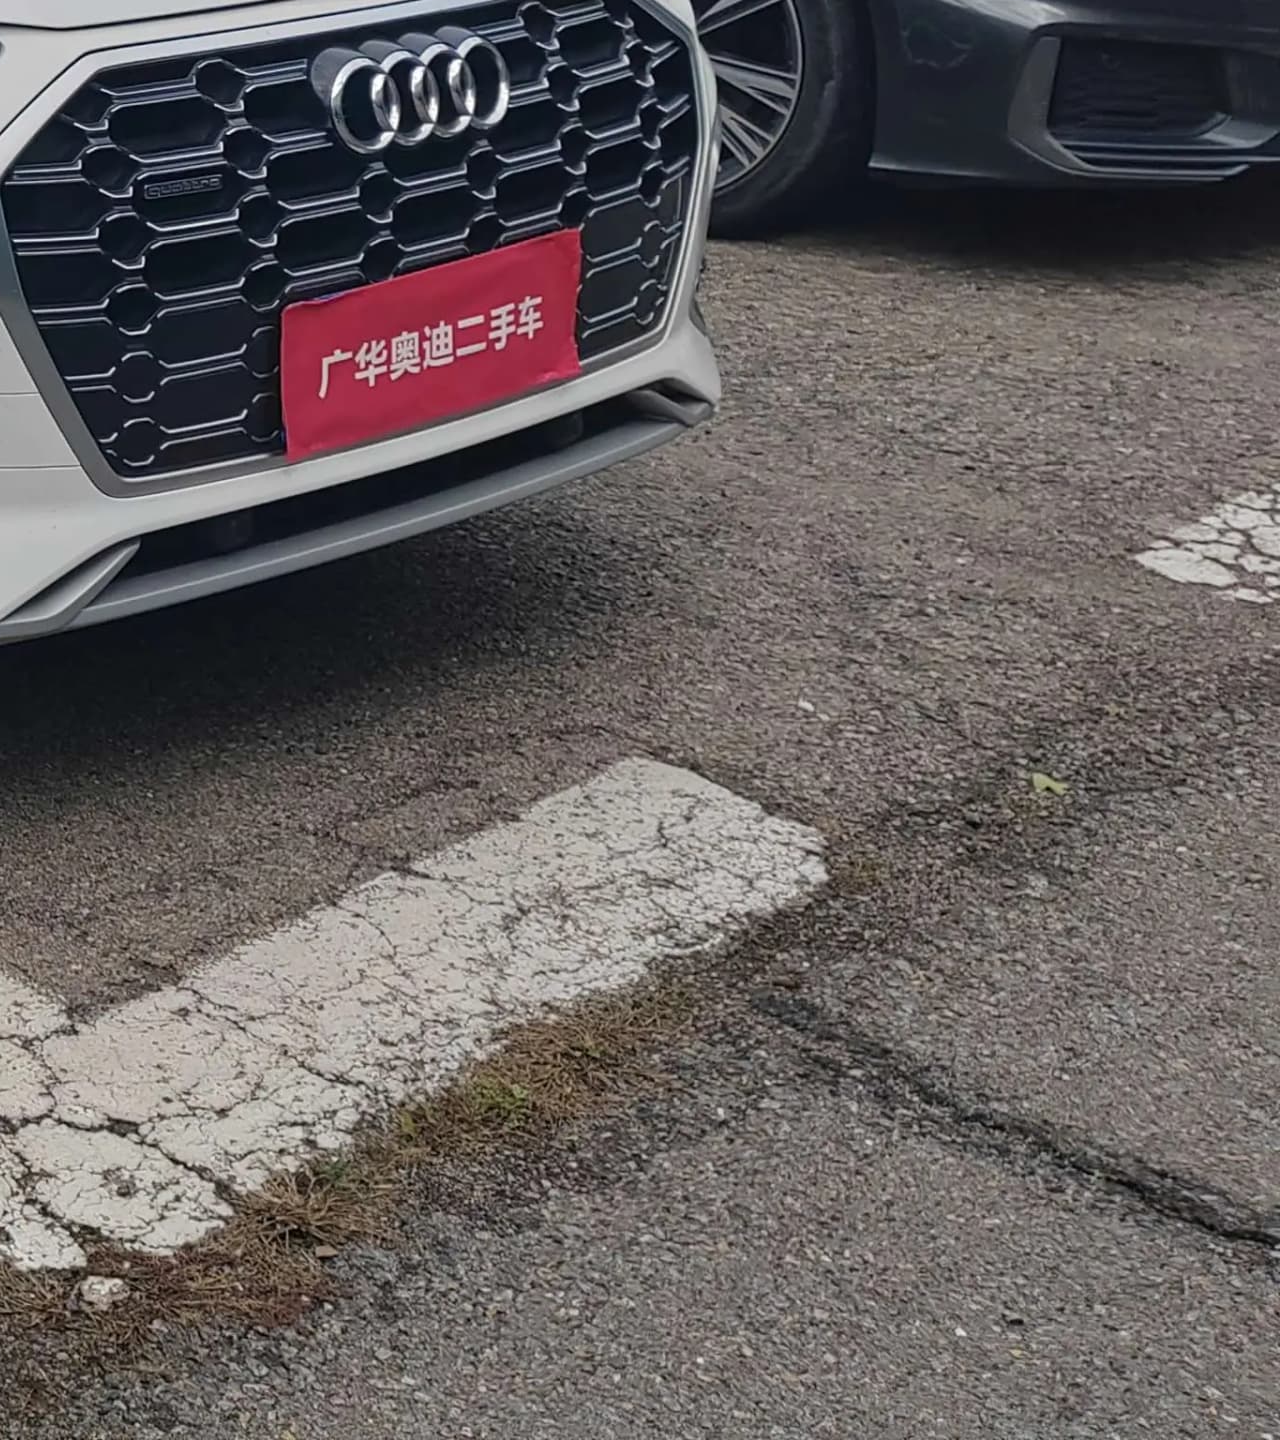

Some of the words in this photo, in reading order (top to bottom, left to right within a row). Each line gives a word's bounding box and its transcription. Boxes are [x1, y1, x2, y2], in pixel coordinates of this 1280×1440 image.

[318, 295, 544, 399] 广华奥迪二手车
